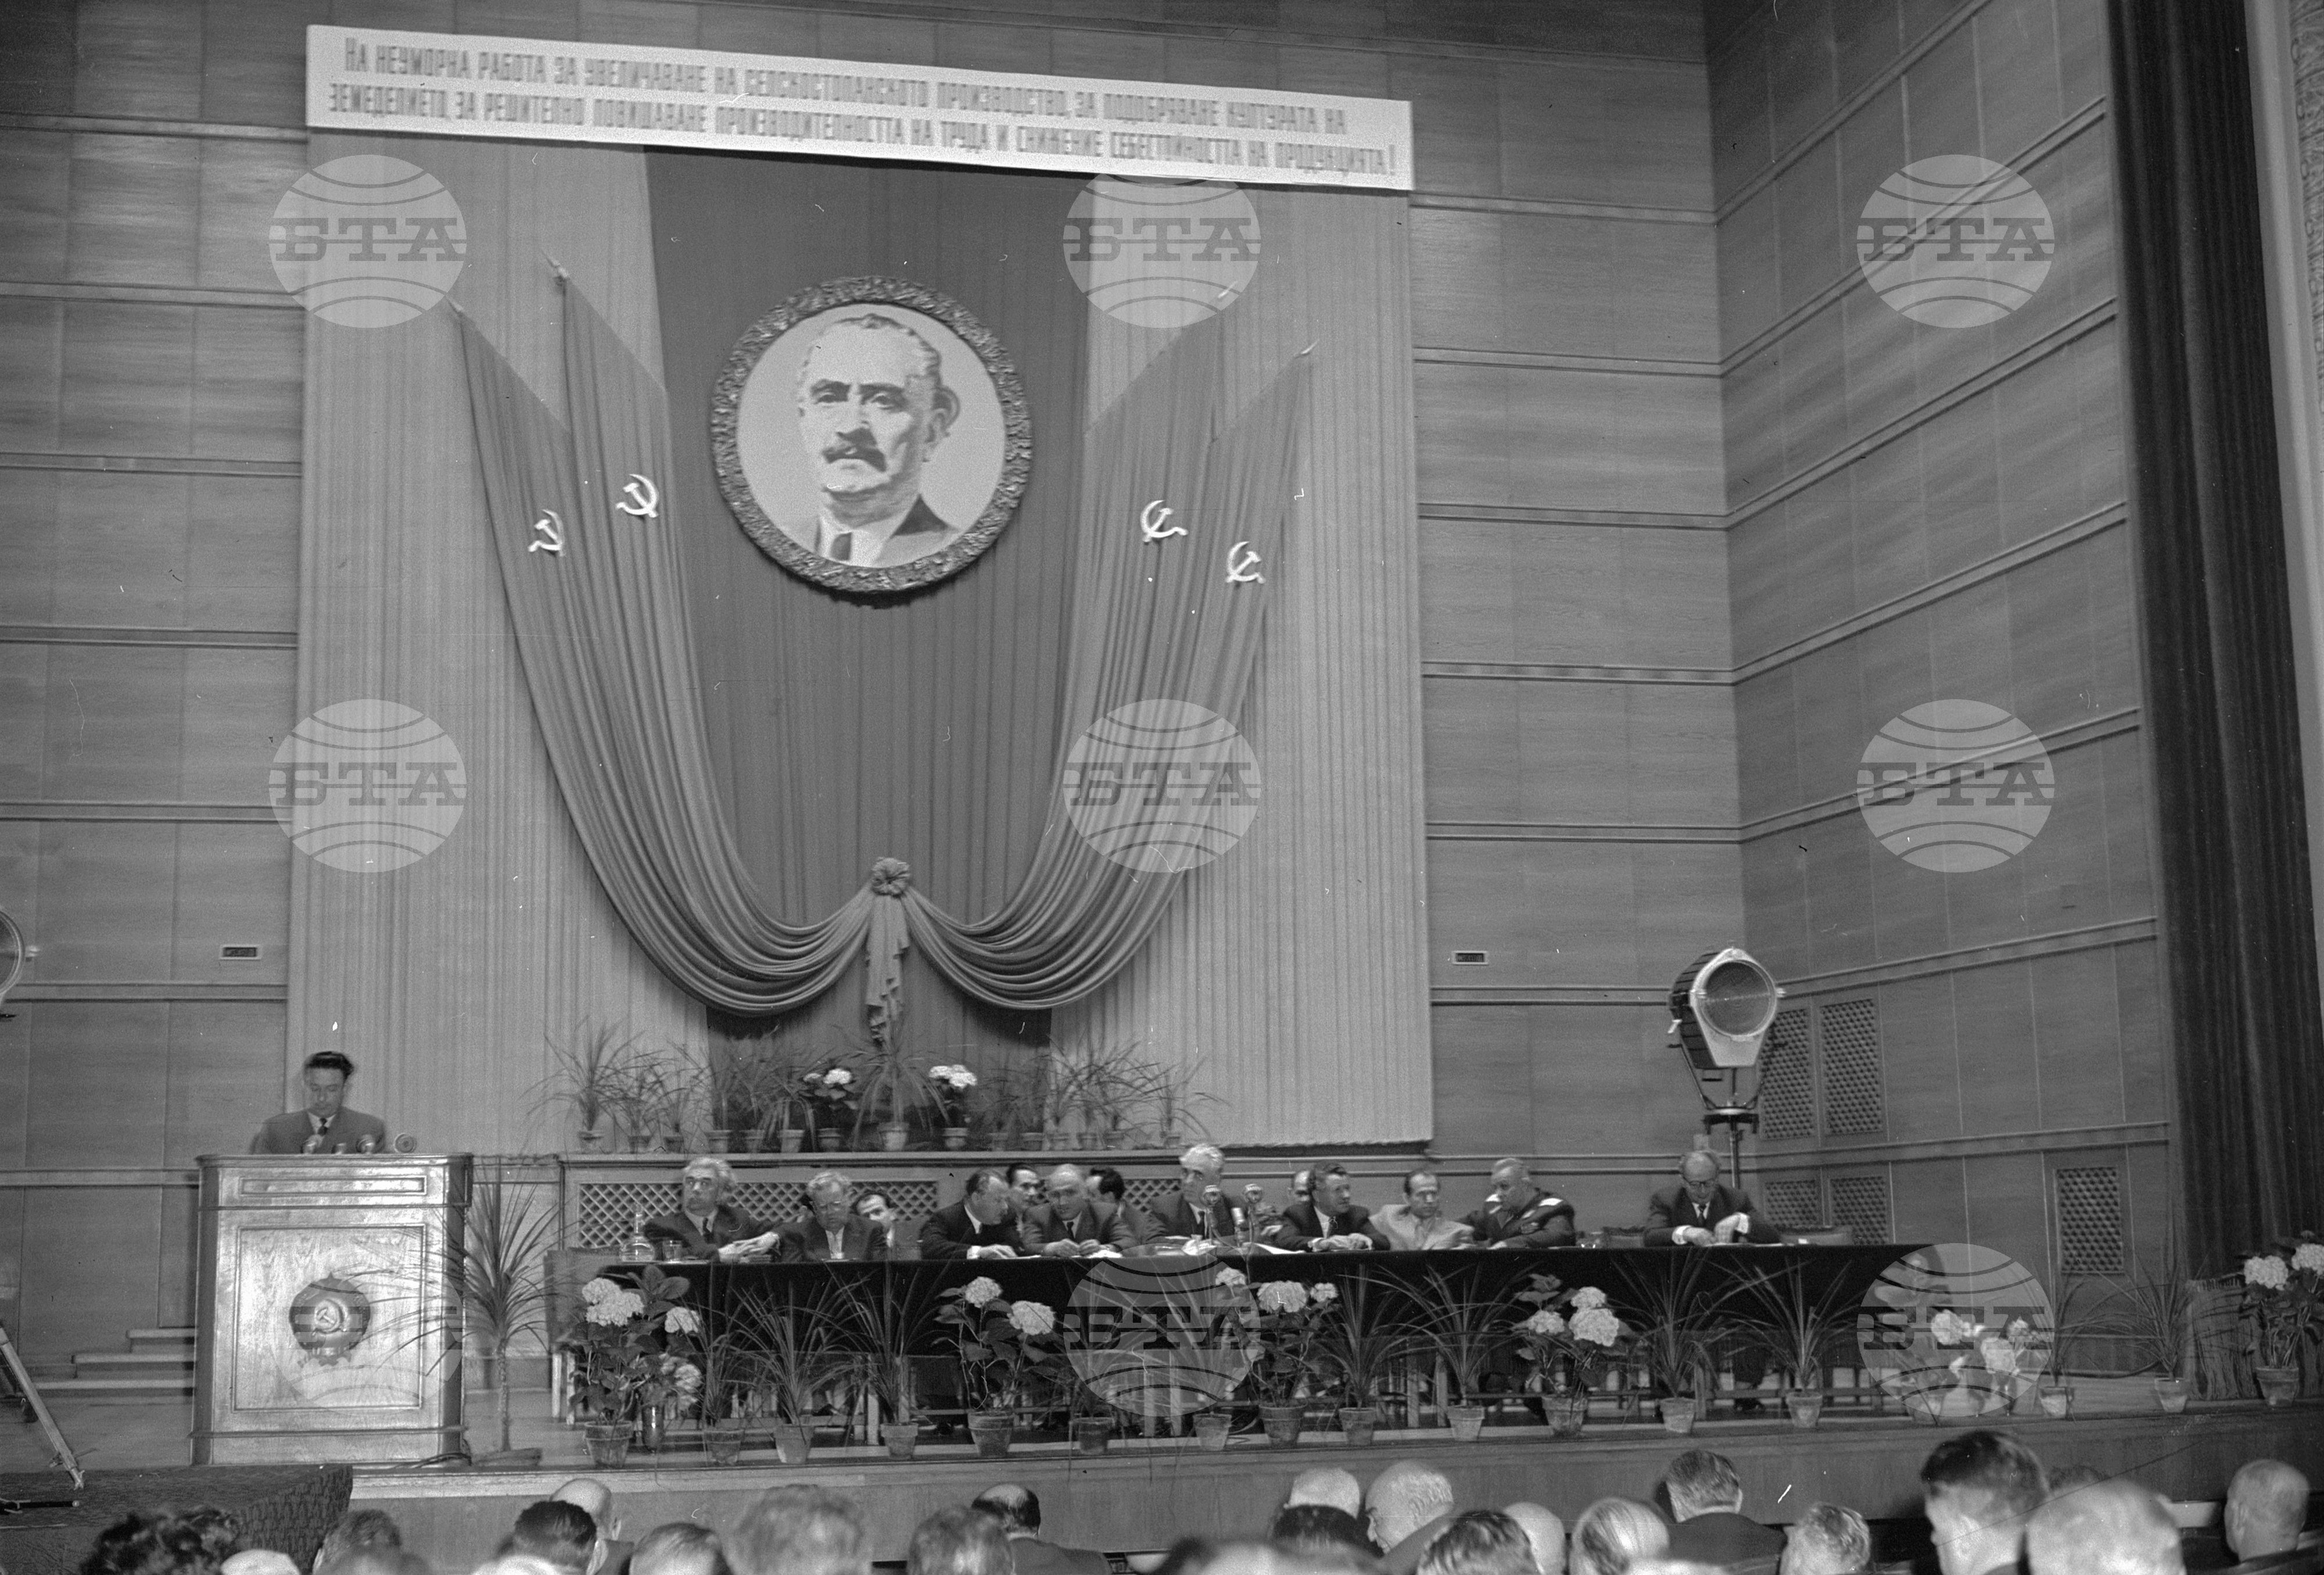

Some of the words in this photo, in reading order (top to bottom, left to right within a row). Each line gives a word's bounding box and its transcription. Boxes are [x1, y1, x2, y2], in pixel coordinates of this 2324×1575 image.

[345, 38, 368, 72] НА
[478, 51, 546, 83] РАБОТА
[554, 56, 578, 84] ЗА
[715, 67, 737, 95] НА
[1075, 91, 1096, 118] ЗА
[1325, 108, 1346, 134] НА
[456, 91, 476, 120] ЗА
[911, 119, 933, 146] НА
[996, 124, 1008, 151] И
[1248, 141, 1268, 167] НА
